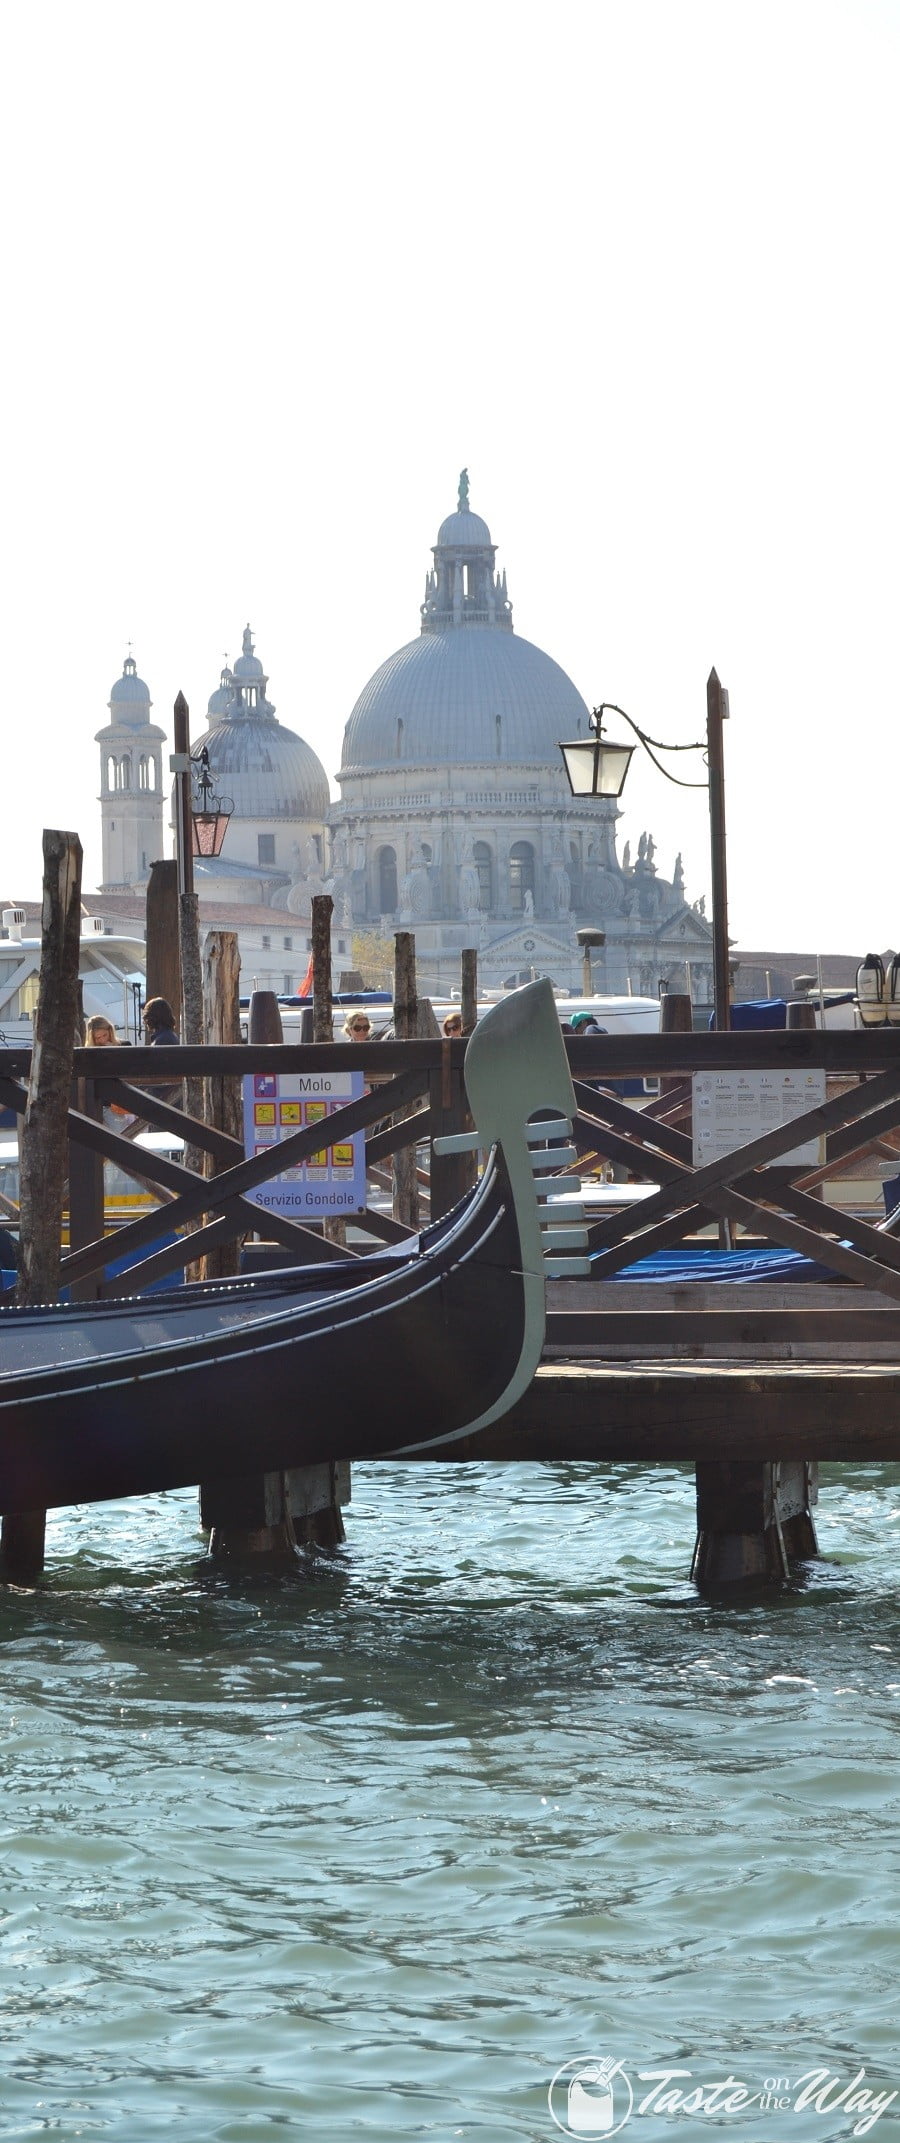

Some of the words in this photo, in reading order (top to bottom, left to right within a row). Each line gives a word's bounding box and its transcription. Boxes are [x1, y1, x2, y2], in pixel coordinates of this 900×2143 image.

[299, 1078, 332, 1092] Molo
[255, 1193, 301, 1206] Servizio
[305, 1192, 354, 1205] Gondole
